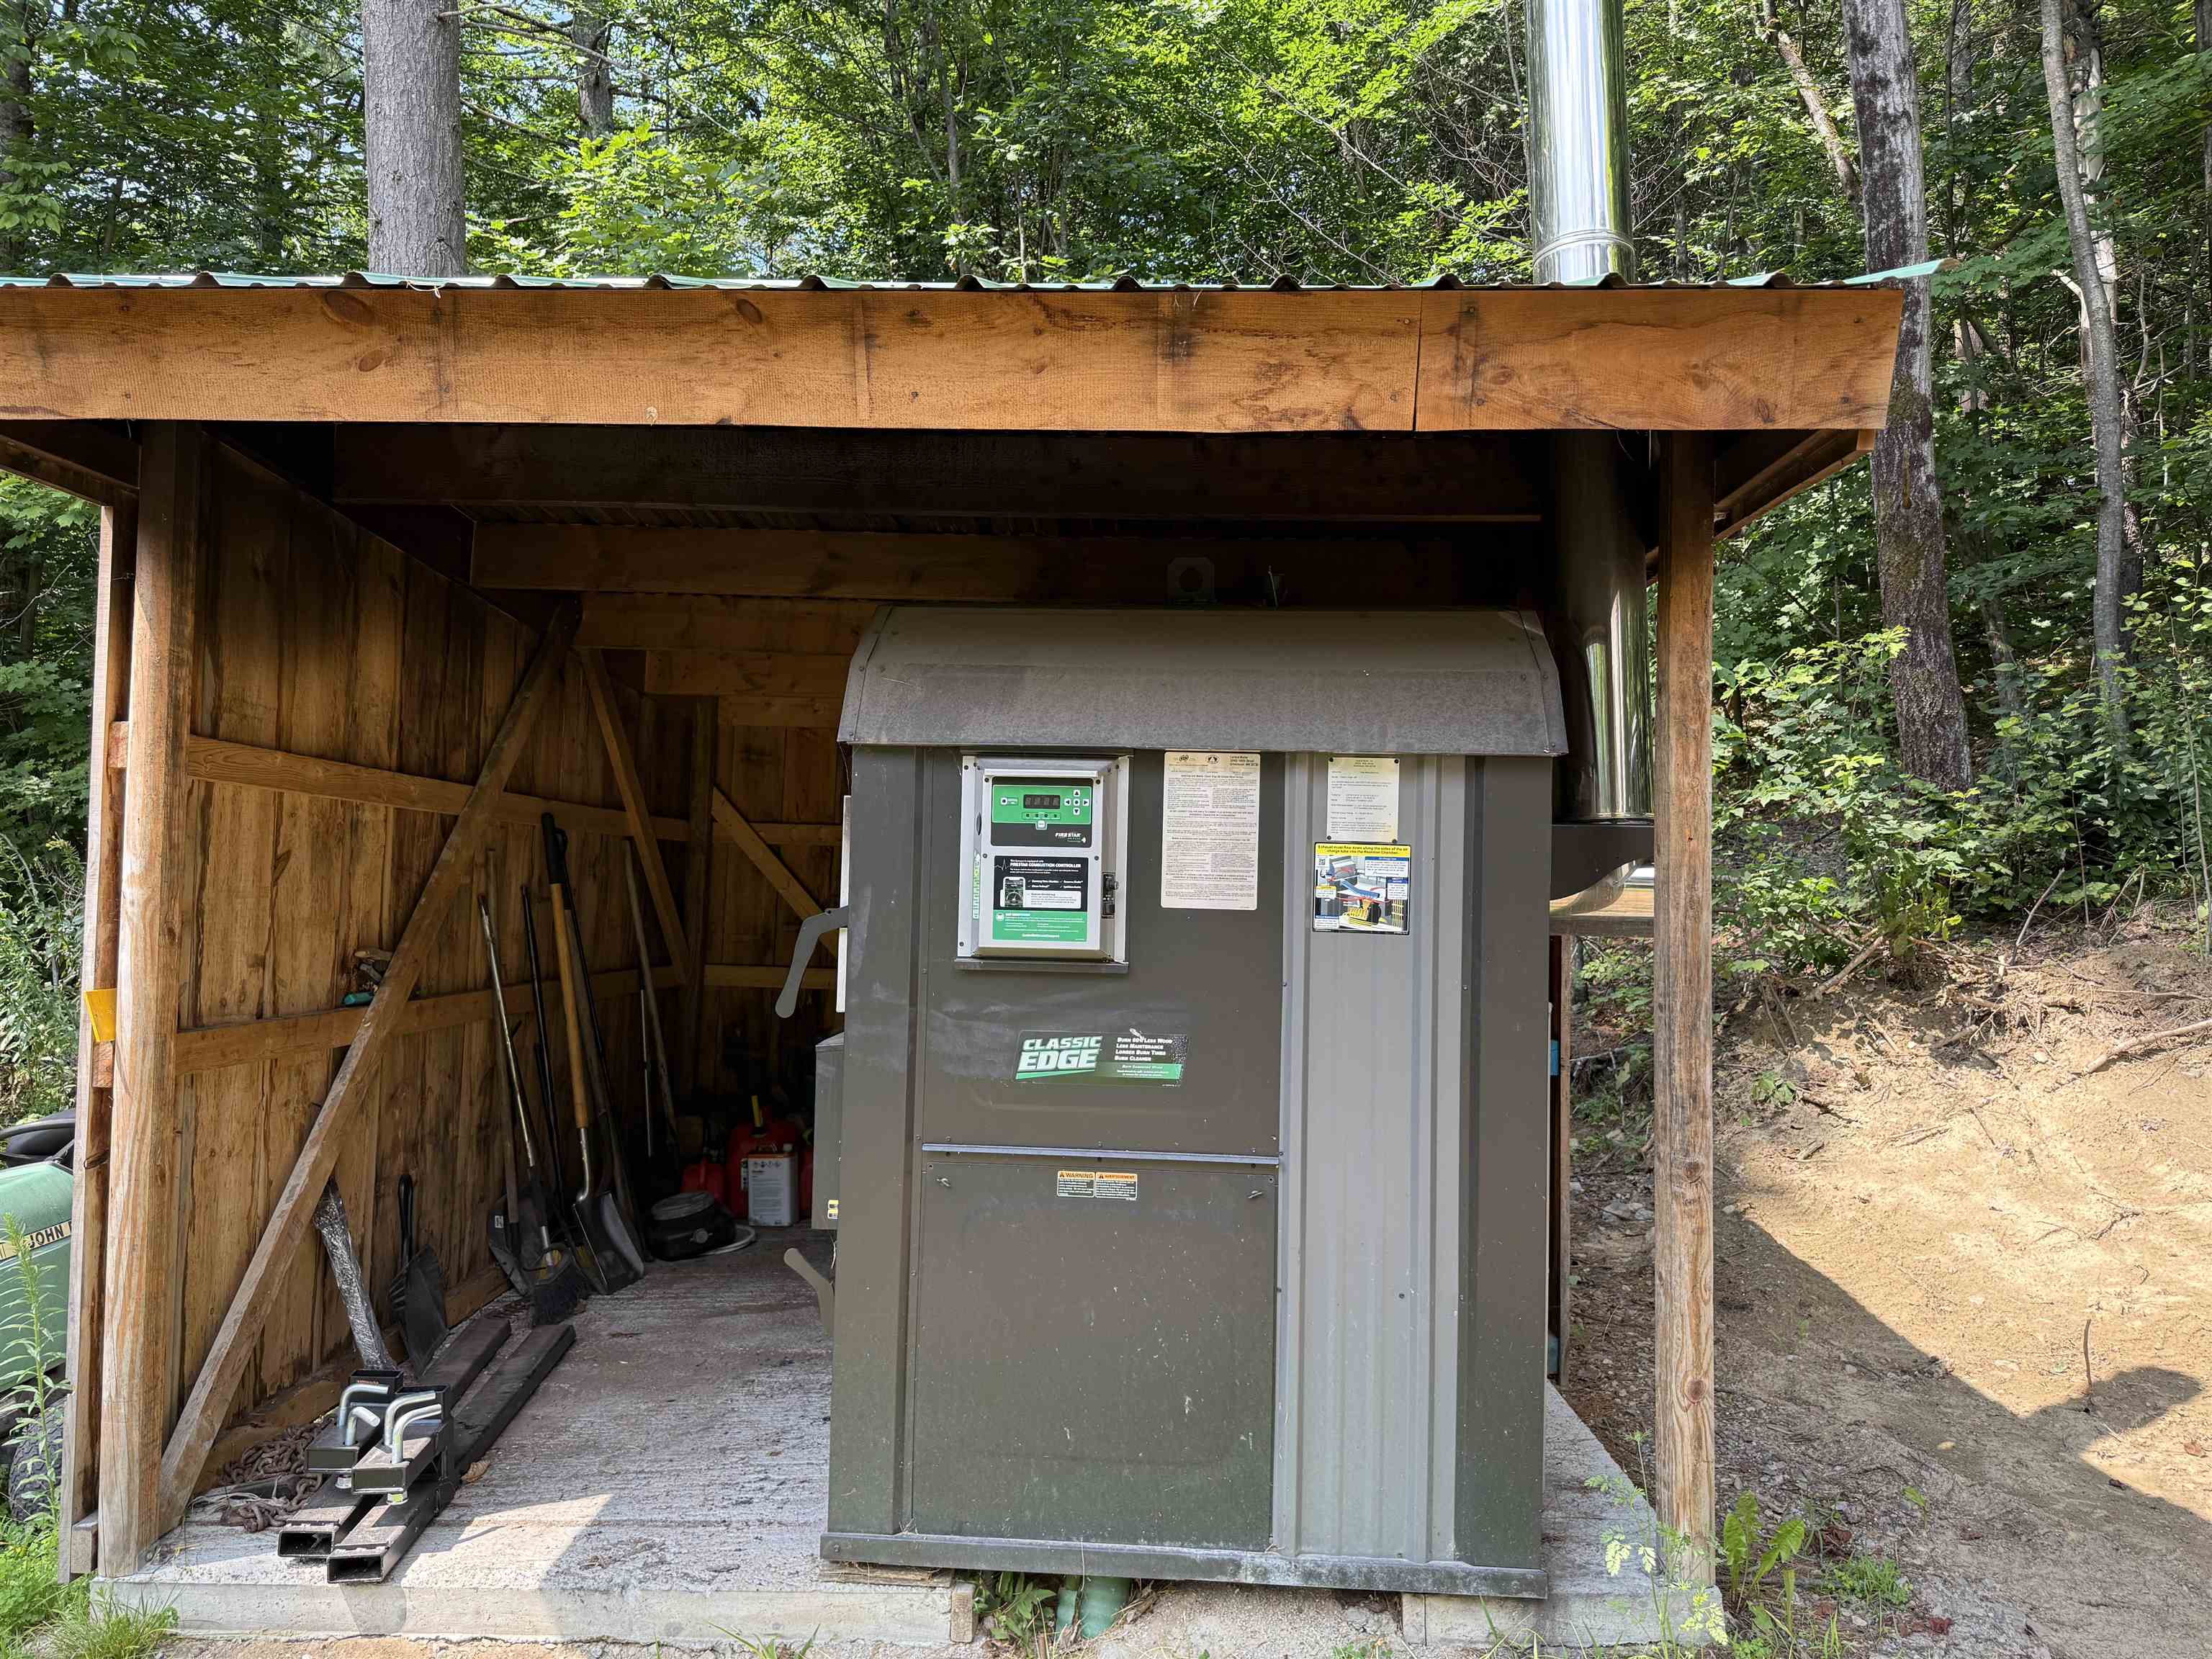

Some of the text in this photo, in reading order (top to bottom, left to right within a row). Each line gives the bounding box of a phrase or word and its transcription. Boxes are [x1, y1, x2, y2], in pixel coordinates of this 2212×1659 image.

[1022, 1035, 1103, 1051] CLASSIC
[1017, 1048, 1101, 1071] EDGE
[28, 1224, 64, 1249] JOHN
